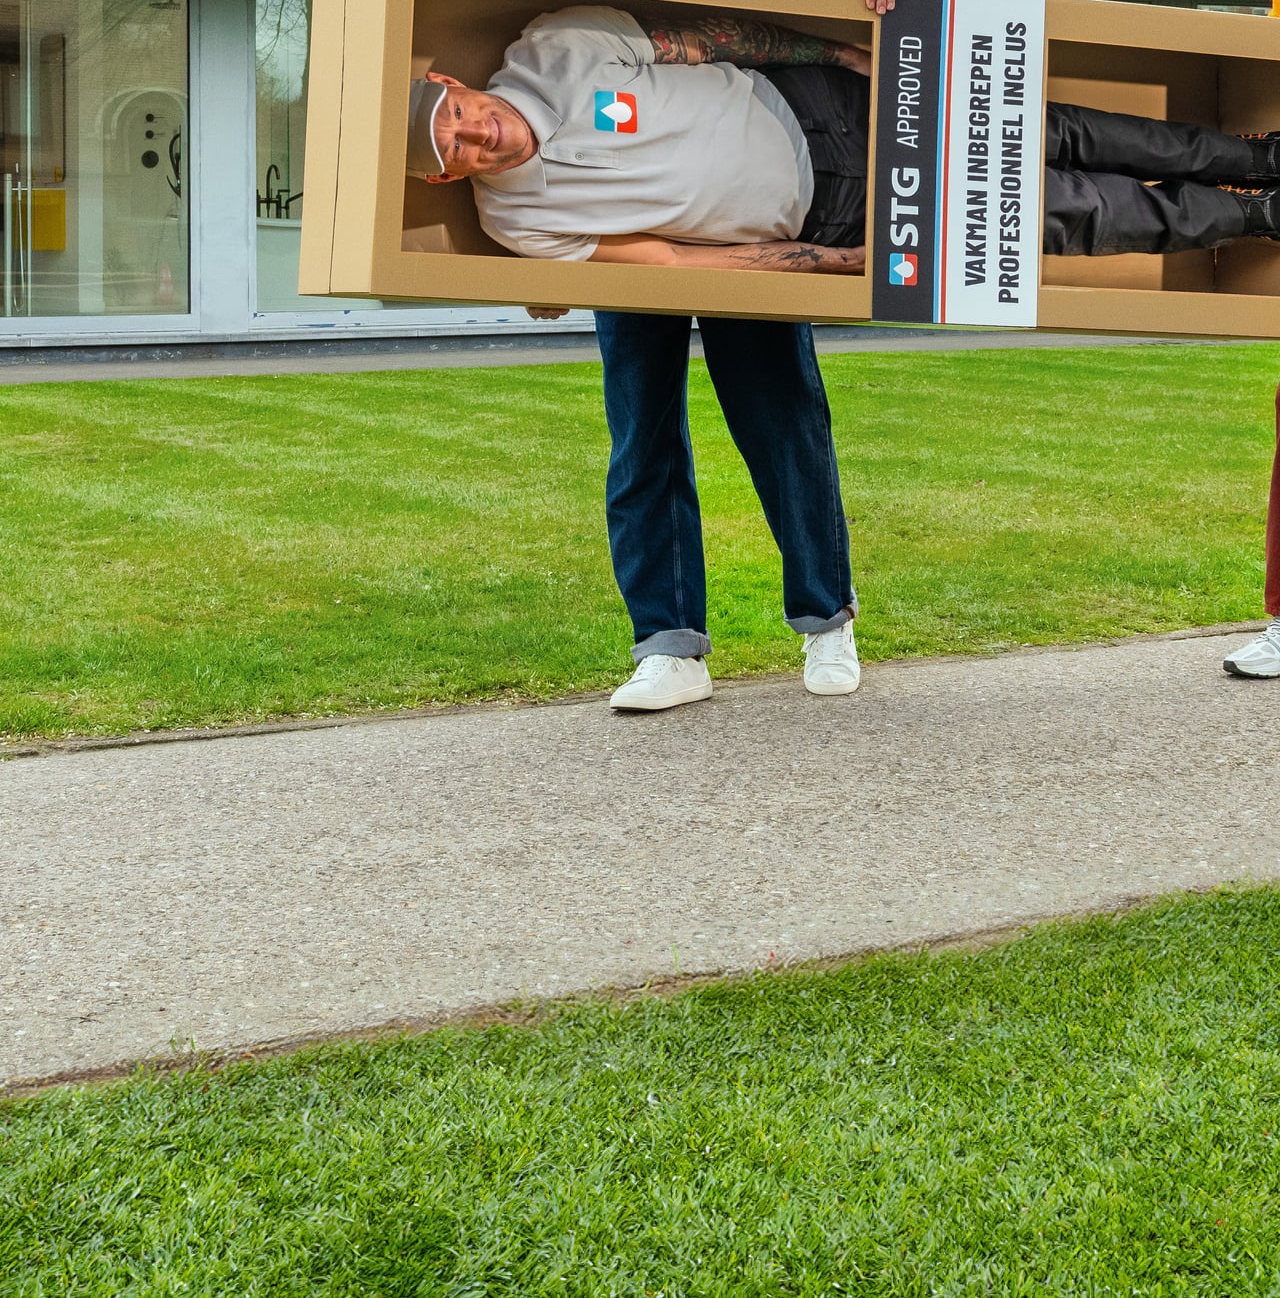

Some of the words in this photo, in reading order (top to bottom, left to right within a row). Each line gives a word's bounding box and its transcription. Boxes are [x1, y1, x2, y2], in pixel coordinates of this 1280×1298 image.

[896, 34, 923, 149] APPROVED
[966, 34, 994, 183] INBEGREPEN
[1003, 21, 1028, 107] INCLUS
[889, 166, 921, 248] STG
[964, 189, 989, 287] VAKMAN
[998, 113, 1024, 304] PROFESSIONNEL
